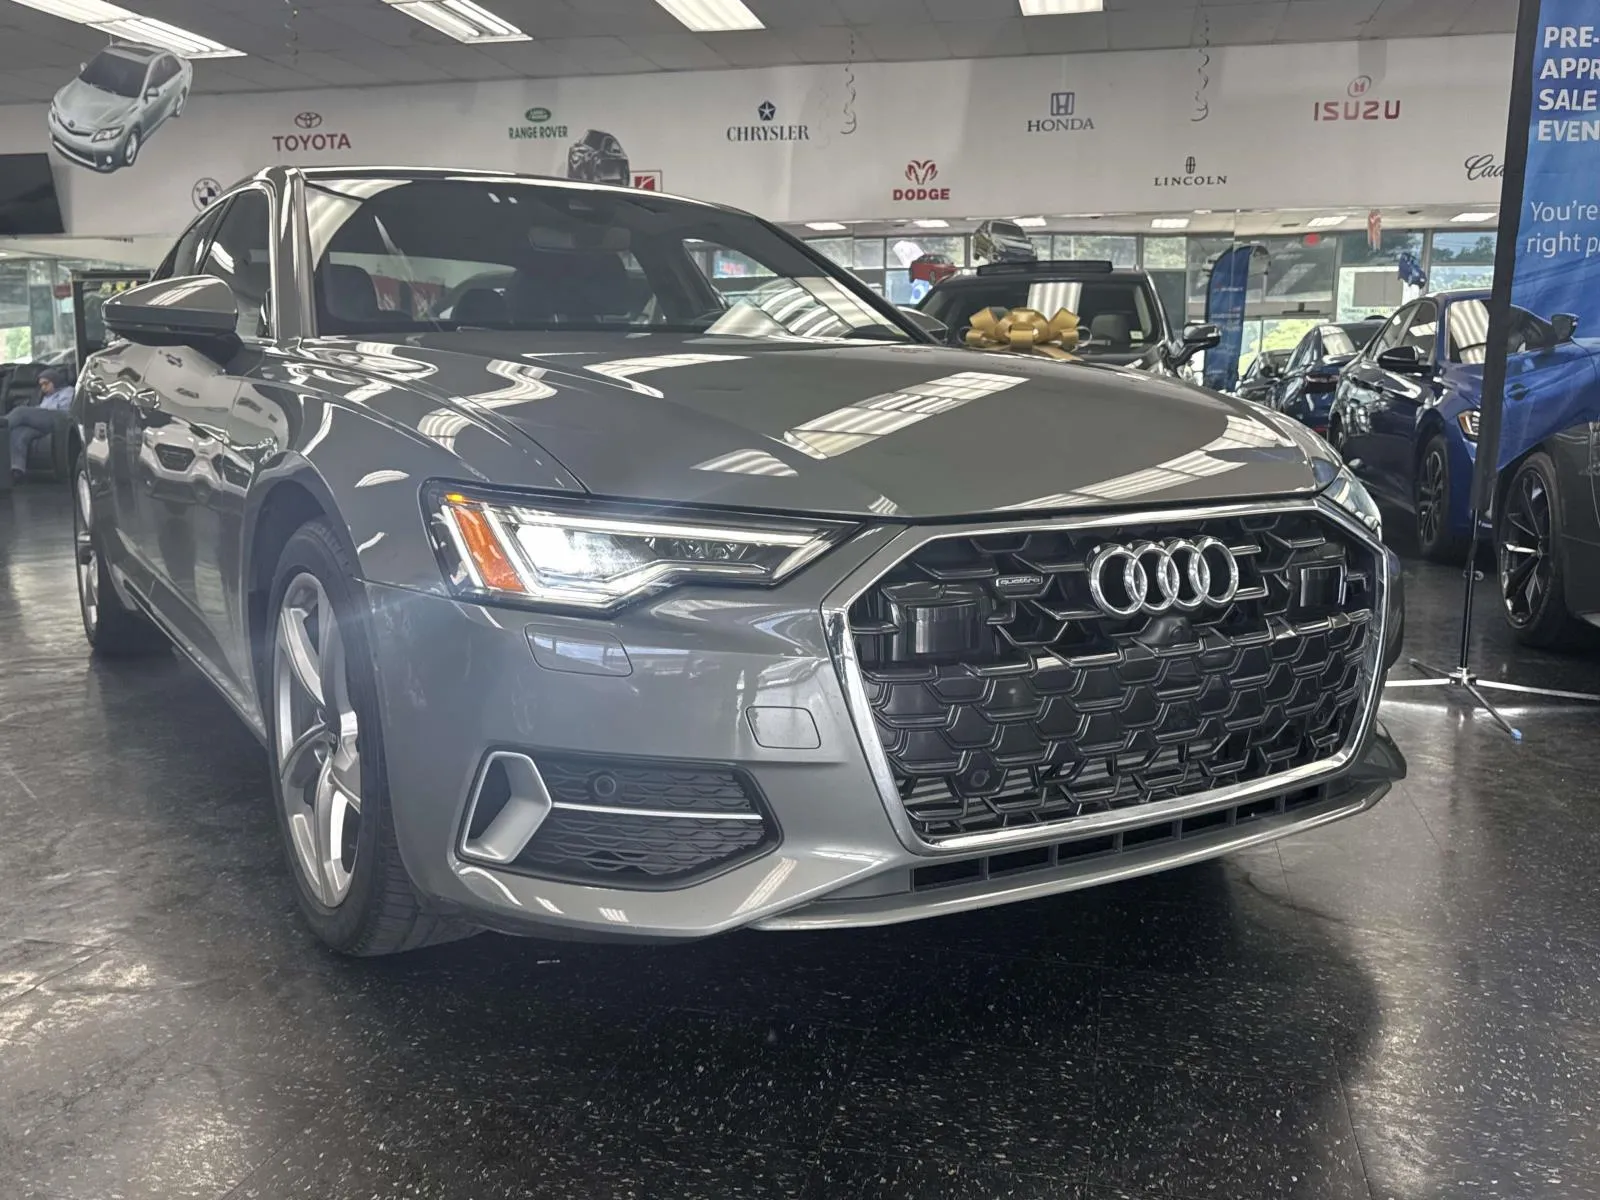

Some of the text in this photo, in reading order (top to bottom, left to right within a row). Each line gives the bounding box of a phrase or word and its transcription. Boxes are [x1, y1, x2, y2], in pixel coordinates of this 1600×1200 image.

[1543, 26, 1600, 48] PRE-
[1540, 58, 1600, 80] APPR
[1539, 88, 1597, 111] SALE
[1314, 100, 1400, 121] ISUZU
[509, 125, 568, 139] RANGE ROVER
[727, 125, 809, 141] CHRYSLER
[1027, 118, 1094, 132] HONDA
[272, 133, 351, 152] TOYOTA
[1154, 176, 1227, 186] LINCOLN
[893, 188, 950, 201] DODGE
[1531, 200, 1598, 221] You’re
[1527, 231, 1581, 258] right
